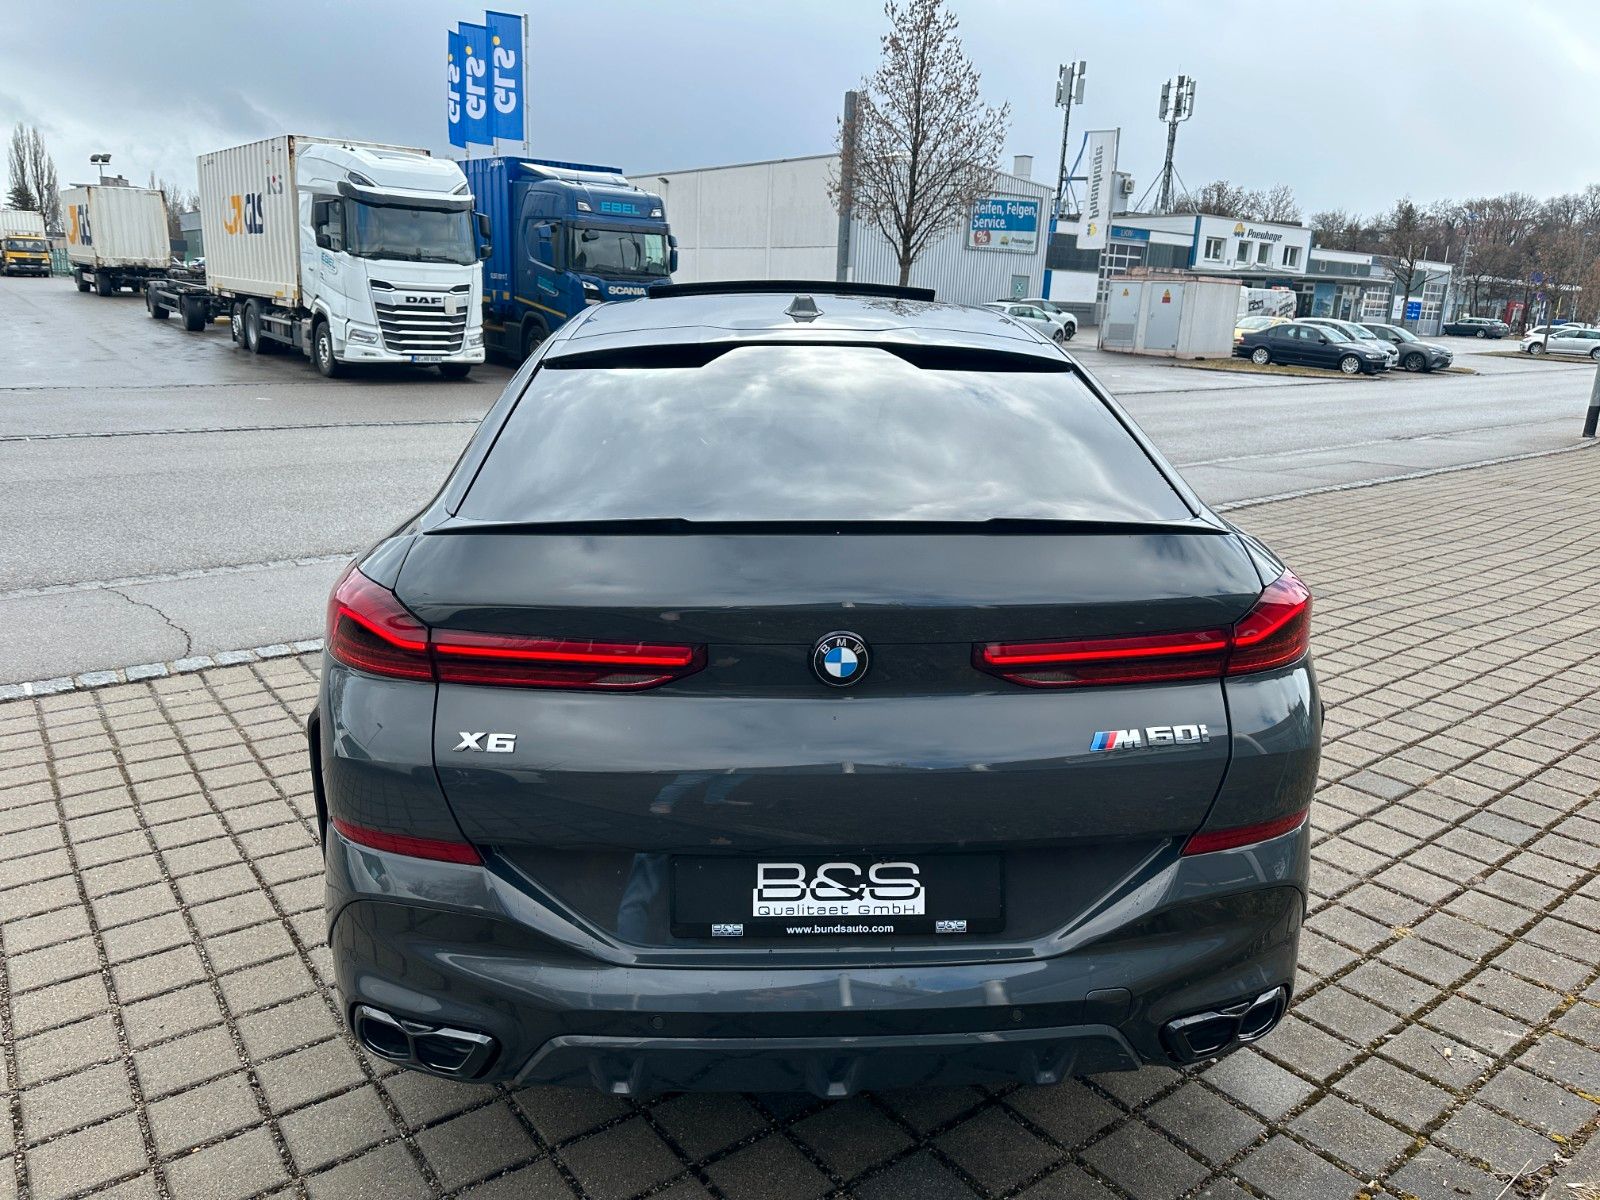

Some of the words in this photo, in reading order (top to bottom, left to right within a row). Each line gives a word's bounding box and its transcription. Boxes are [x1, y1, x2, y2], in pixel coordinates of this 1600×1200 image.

[600, 201, 641, 215] EBEL
[974, 201, 1005, 216] Reifen,
[1006, 203, 1037, 219] Felgen,
[973, 215, 1007, 229] Service.
[1247, 228, 1283, 242] Pneuhage
[608, 285, 647, 296] SCANIA
[405, 296, 442, 304] DAF
[820, 638, 864, 655] BMW
[452, 732, 518, 753] X6
[757, 862, 921, 902] B&S
[758, 904, 849, 916] Qualitaet
[786, 924, 894, 935] www.bundsauto.com
